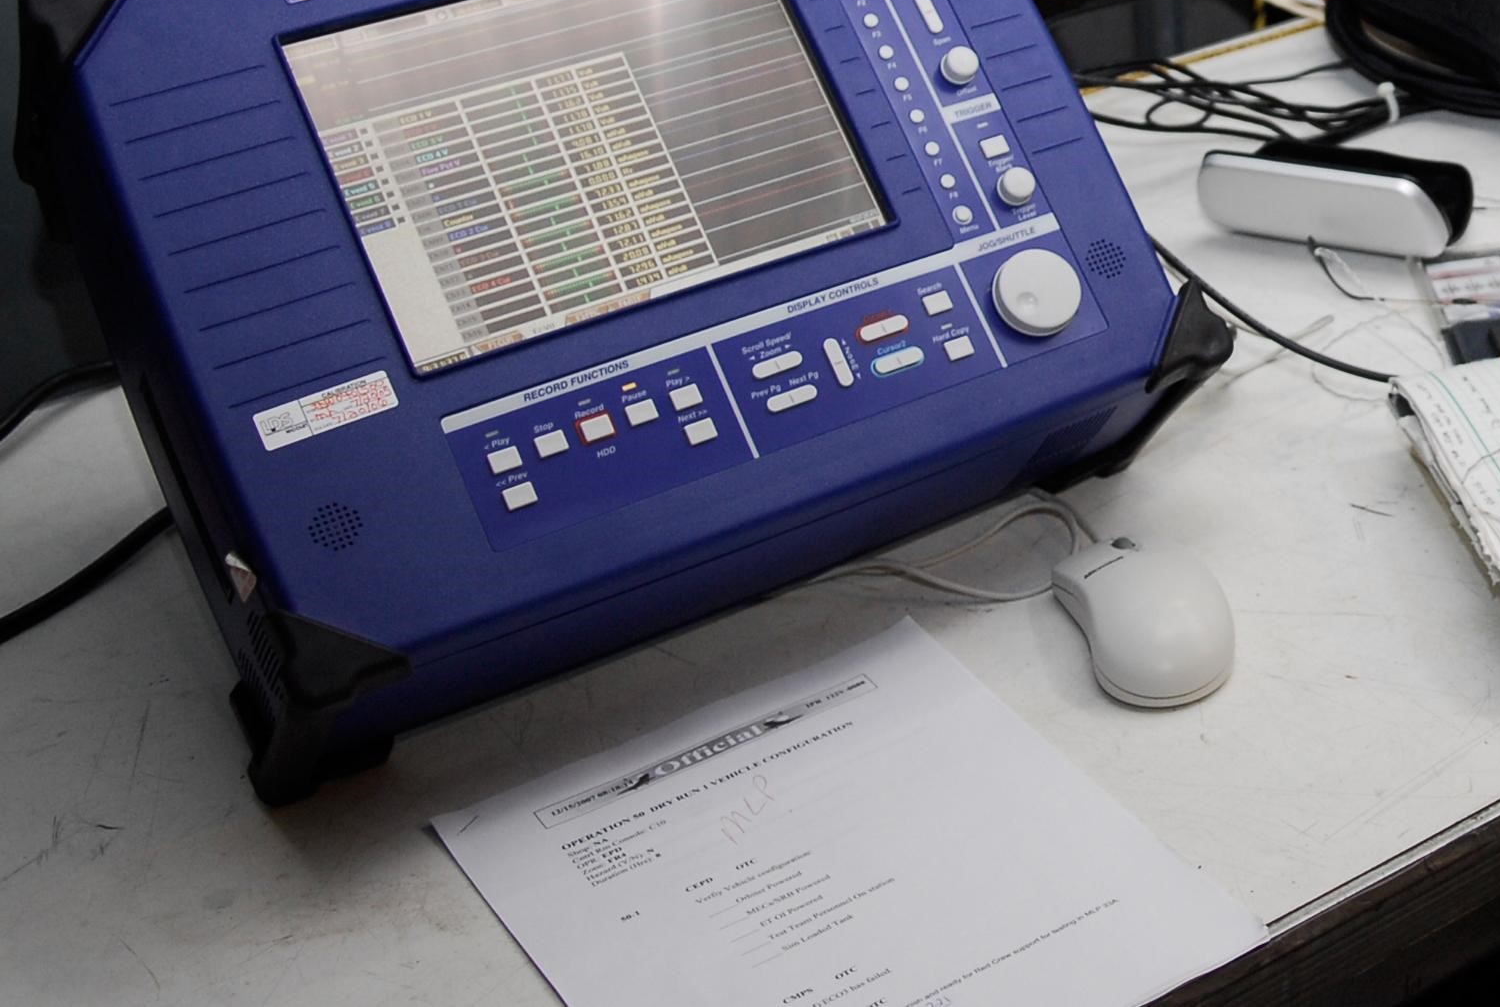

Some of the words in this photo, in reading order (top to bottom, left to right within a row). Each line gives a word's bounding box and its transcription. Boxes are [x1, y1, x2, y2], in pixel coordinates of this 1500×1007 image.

[953, 100, 993, 119] TRIGGER
[959, 223, 979, 235] Menu
[977, 225, 1036, 252] JOG/SHUTTLE
[786, 293, 826, 314] DISPLAY
[828, 277, 879, 301] CONTROLS
[917, 282, 942, 295] Search
[932, 330, 950, 343] Hard
[950, 325, 970, 339] Copy
[741, 339, 766, 355] Scroll
[759, 345, 782, 359] Zoom
[523, 379, 568, 403] RECORD
[570, 359, 630, 386] FUNCTIONS
[665, 375, 684, 388] Play
[788, 374, 806, 387] Next
[621, 388, 647, 403] Pause
[751, 386, 769, 399] Prev
[574, 403, 605, 419] Record
[677, 412, 694, 424] Next
[533, 421, 554, 435] Stop
[491, 435, 510, 448] Play
[596, 445, 616, 459] HDD
[508, 470, 528, 483] Prev
[654, 724, 763, 776] Official
[561, 818, 631, 851] OPERATION
[650, 799, 673, 813] DRY
[710, 761, 760, 786] VEHICLE
[761, 720, 853, 763] CONFIGURATION
[602, 846, 622, 859] EPD
[835, 966, 857, 980] OTC
